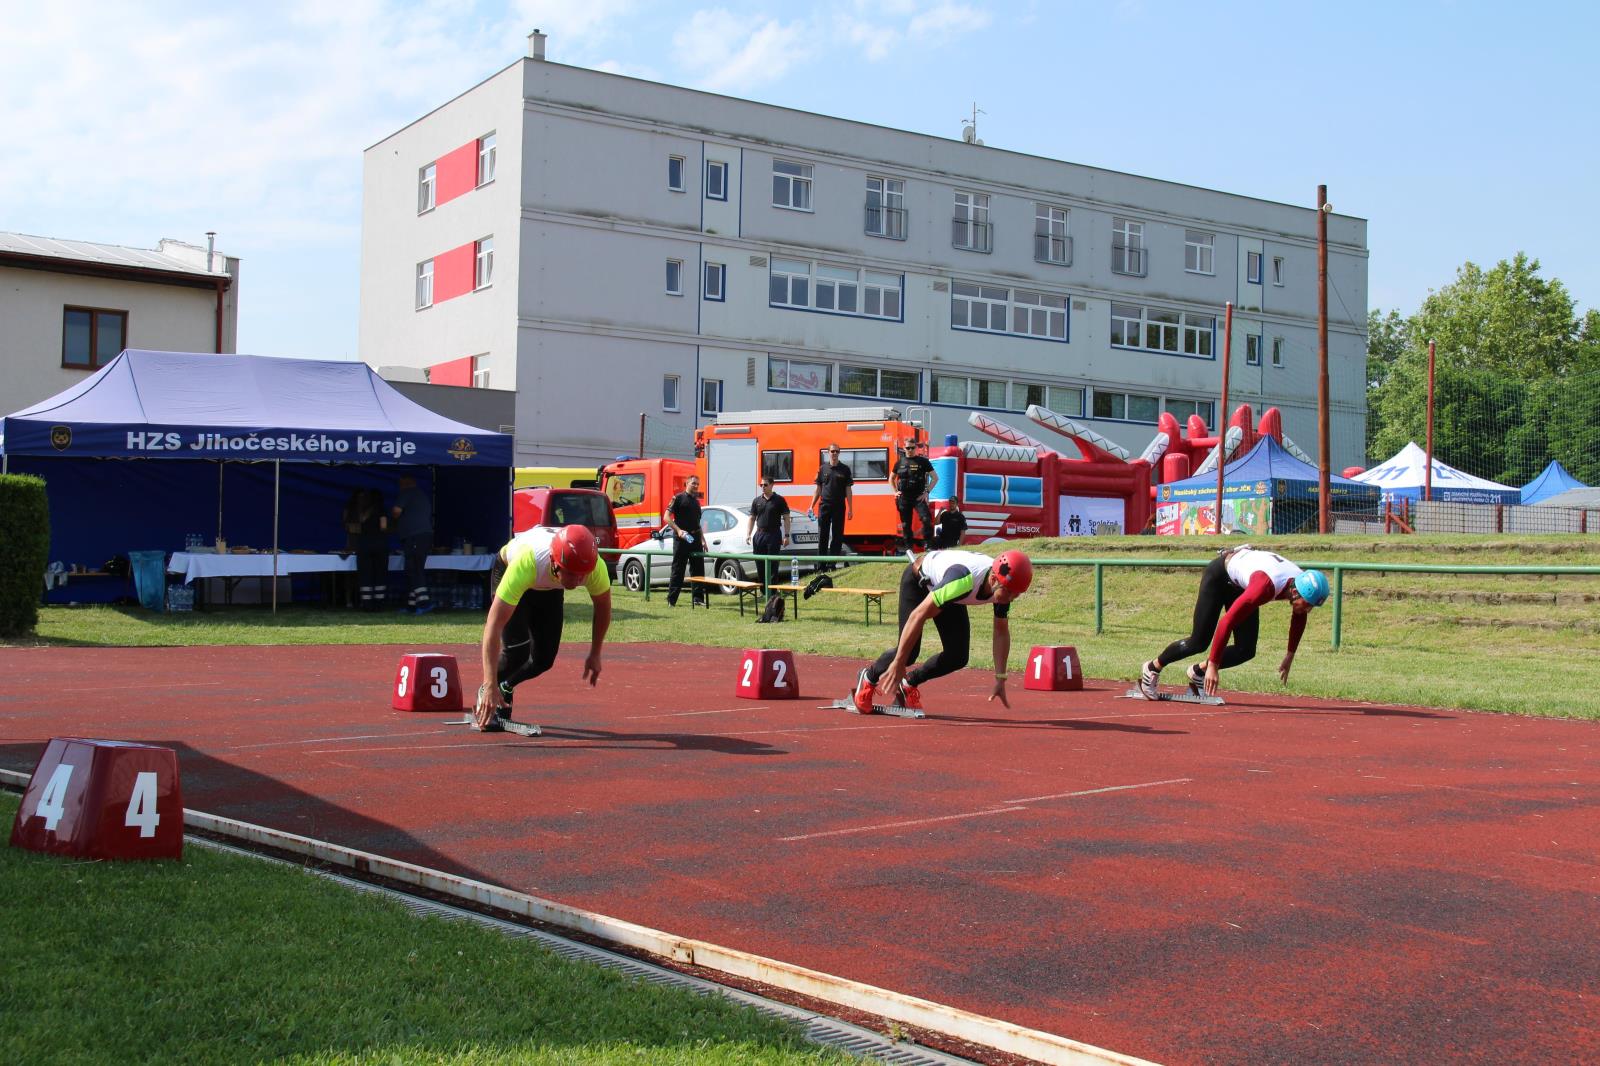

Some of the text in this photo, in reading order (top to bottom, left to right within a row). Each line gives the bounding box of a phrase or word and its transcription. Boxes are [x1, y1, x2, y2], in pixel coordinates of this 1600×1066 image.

[127, 431, 416, 458] HZS Jihočeského kraje
[1489, 494, 1501, 503] 211
[398, 666, 409, 697] 3
[741, 658, 753, 687] 2
[772, 660, 787, 688] 2
[1033, 655, 1043, 680] 1
[1062, 655, 1073, 680] 1
[430, 667, 448, 699] 3
[35, 764, 74, 831] 4
[125, 771, 160, 838] 4
